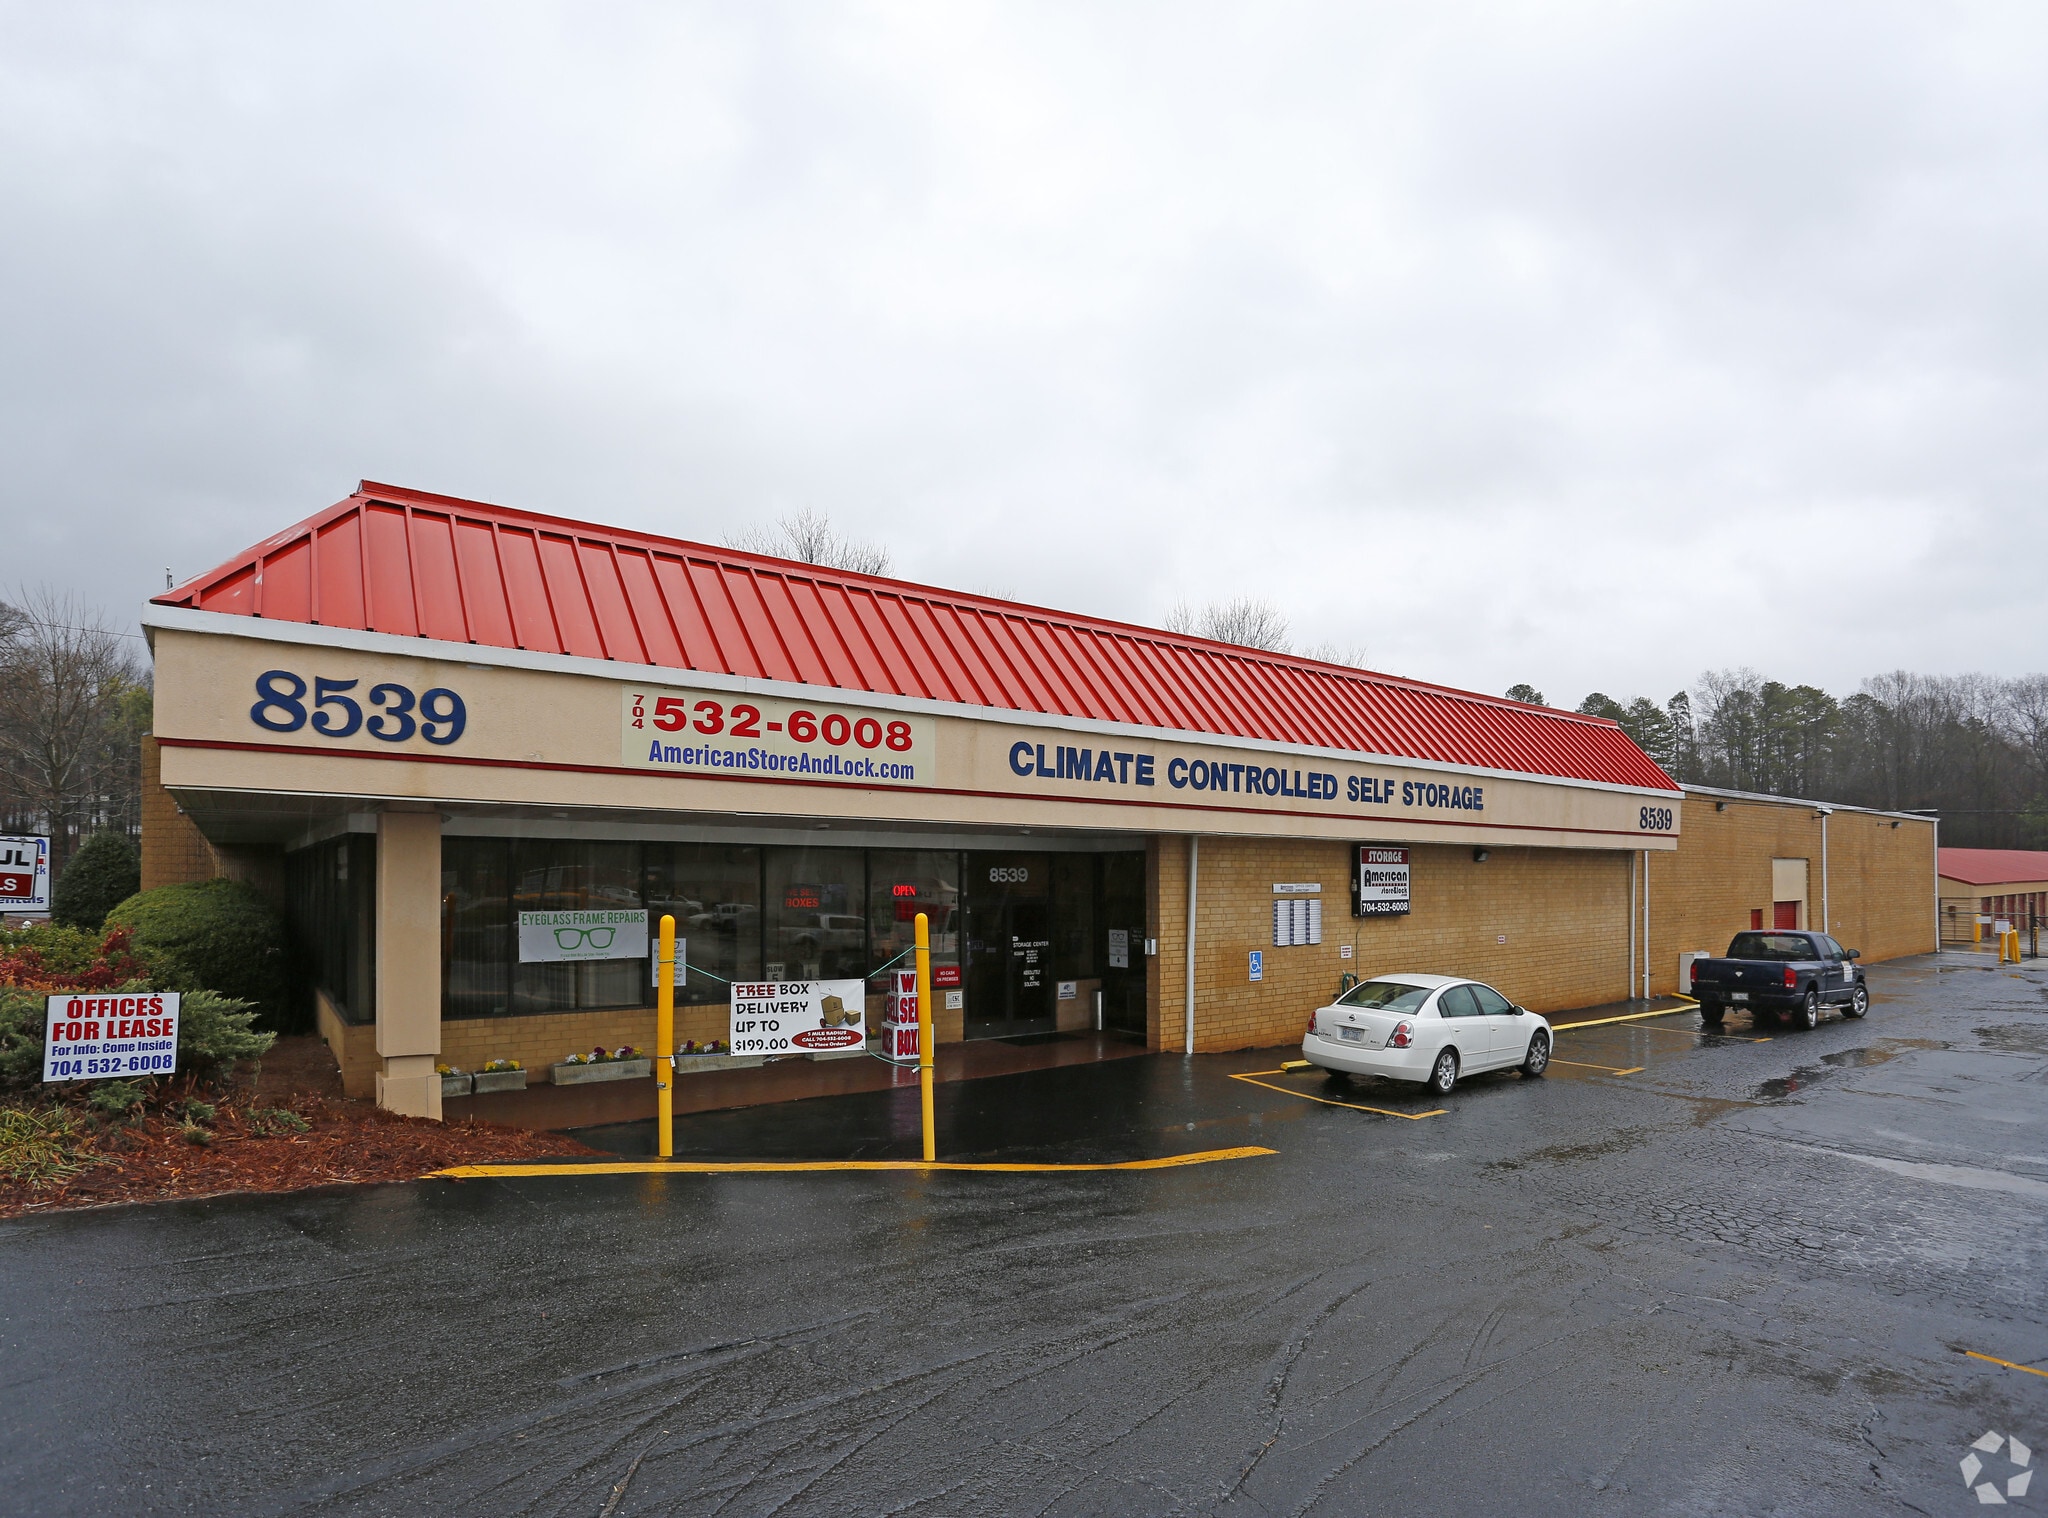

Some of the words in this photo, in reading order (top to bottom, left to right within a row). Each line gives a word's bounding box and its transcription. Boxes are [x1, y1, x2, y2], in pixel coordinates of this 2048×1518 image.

[250, 670, 467, 745] 8539
[631, 694, 645, 730] 704
[652, 696, 914, 752] 532-6008
[648, 739, 915, 780] AmericanStoreAndLock.com
[1008, 741, 1156, 786] CLIMATE
[1167, 757, 1339, 801] CONTROLLED
[1346, 775, 1396, 805] SELF
[1402, 781, 1484, 811] STORAGE
[1639, 806, 1673, 830] 8539
[1368, 850, 1403, 863] STORAGE
[989, 867, 1029, 882] 8539
[1364, 869, 1408, 887] American
[893, 885, 917, 897] OPEN
[785, 897, 820, 908] BOXES
[1362, 902, 1409, 912] 704-532-6008
[521, 913, 571, 926] EYEGLASS
[573, 912, 605, 925] FRAME
[607, 911, 646, 924] REPAIRS
[766, 965, 784, 973] SLOW
[736, 984, 776, 997] FREE
[779, 983, 810, 995] BOX
[900, 973, 916, 993] W
[66, 997, 164, 1019] OFFICES
[735, 1001, 809, 1015] DELIVERY
[52, 1021, 100, 1042] FOR
[106, 1018, 174, 1039] LEASE
[735, 1021, 756, 1033] UP
[760, 1020, 780, 1032] TO
[51, 1045, 72, 1057] For
[73, 1043, 100, 1056] Info:
[102, 1042, 135, 1054] Come
[137, 1040, 173, 1052] Inside
[735, 1038, 788, 1051] $199.00
[50, 1060, 83, 1077] 704
[87, 1054, 173, 1075] 532-6008
